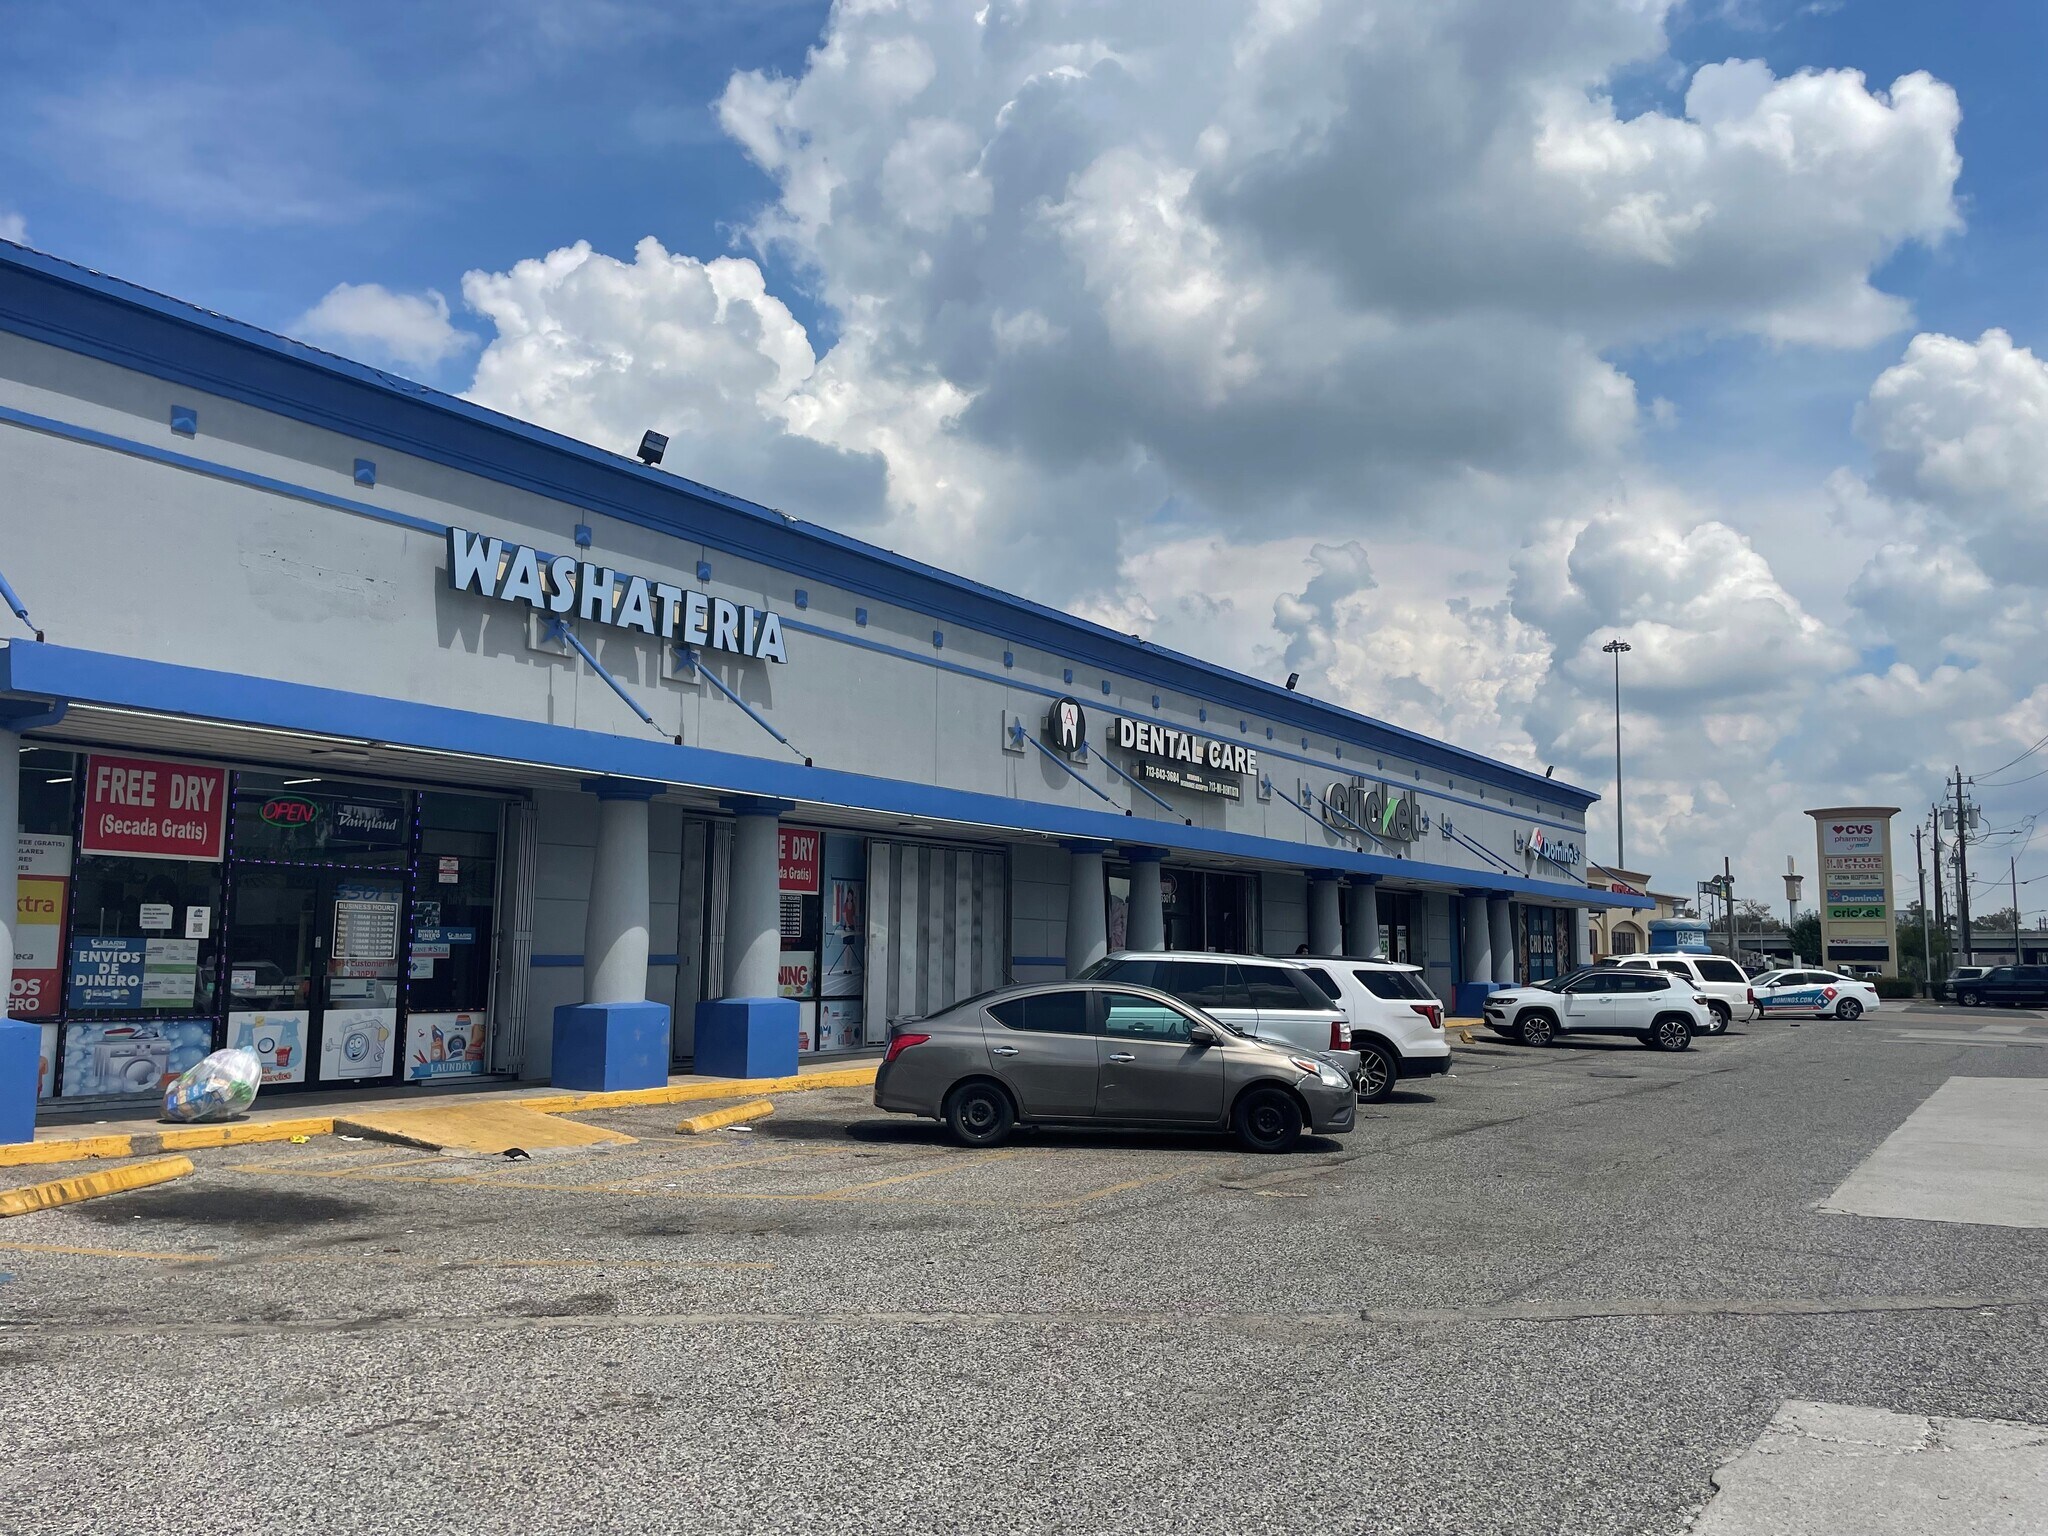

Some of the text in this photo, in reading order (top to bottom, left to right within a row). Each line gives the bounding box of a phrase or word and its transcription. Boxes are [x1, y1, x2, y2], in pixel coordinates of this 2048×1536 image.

[449, 527, 788, 664] WASHATERIA
[1120, 717, 1258, 775] DENTAL CARE
[95, 766, 217, 812] FREE DRY
[263, 801, 315, 822] OPEN
[1326, 776, 1420, 842] cricket
[100, 813, 207, 845] (Secada Gratis)
[338, 811, 397, 832] Dairyland
[1845, 825, 1873, 835] CVS
[792, 836, 815, 861] DRY
[1834, 836, 1873, 844] pharmacy
[789, 866, 812, 884] Gratis)
[1841, 894, 1884, 902] Domino's
[1833, 908, 1881, 918] cricket
[1530, 934, 1553, 953] CHOCES
[14, 952, 34, 960] eca
[79, 947, 141, 964] ENVÍOS
[98, 963, 120, 974] DE
[75, 975, 140, 987] DINERO
[430, 1062, 474, 1072] LAUNDRY
